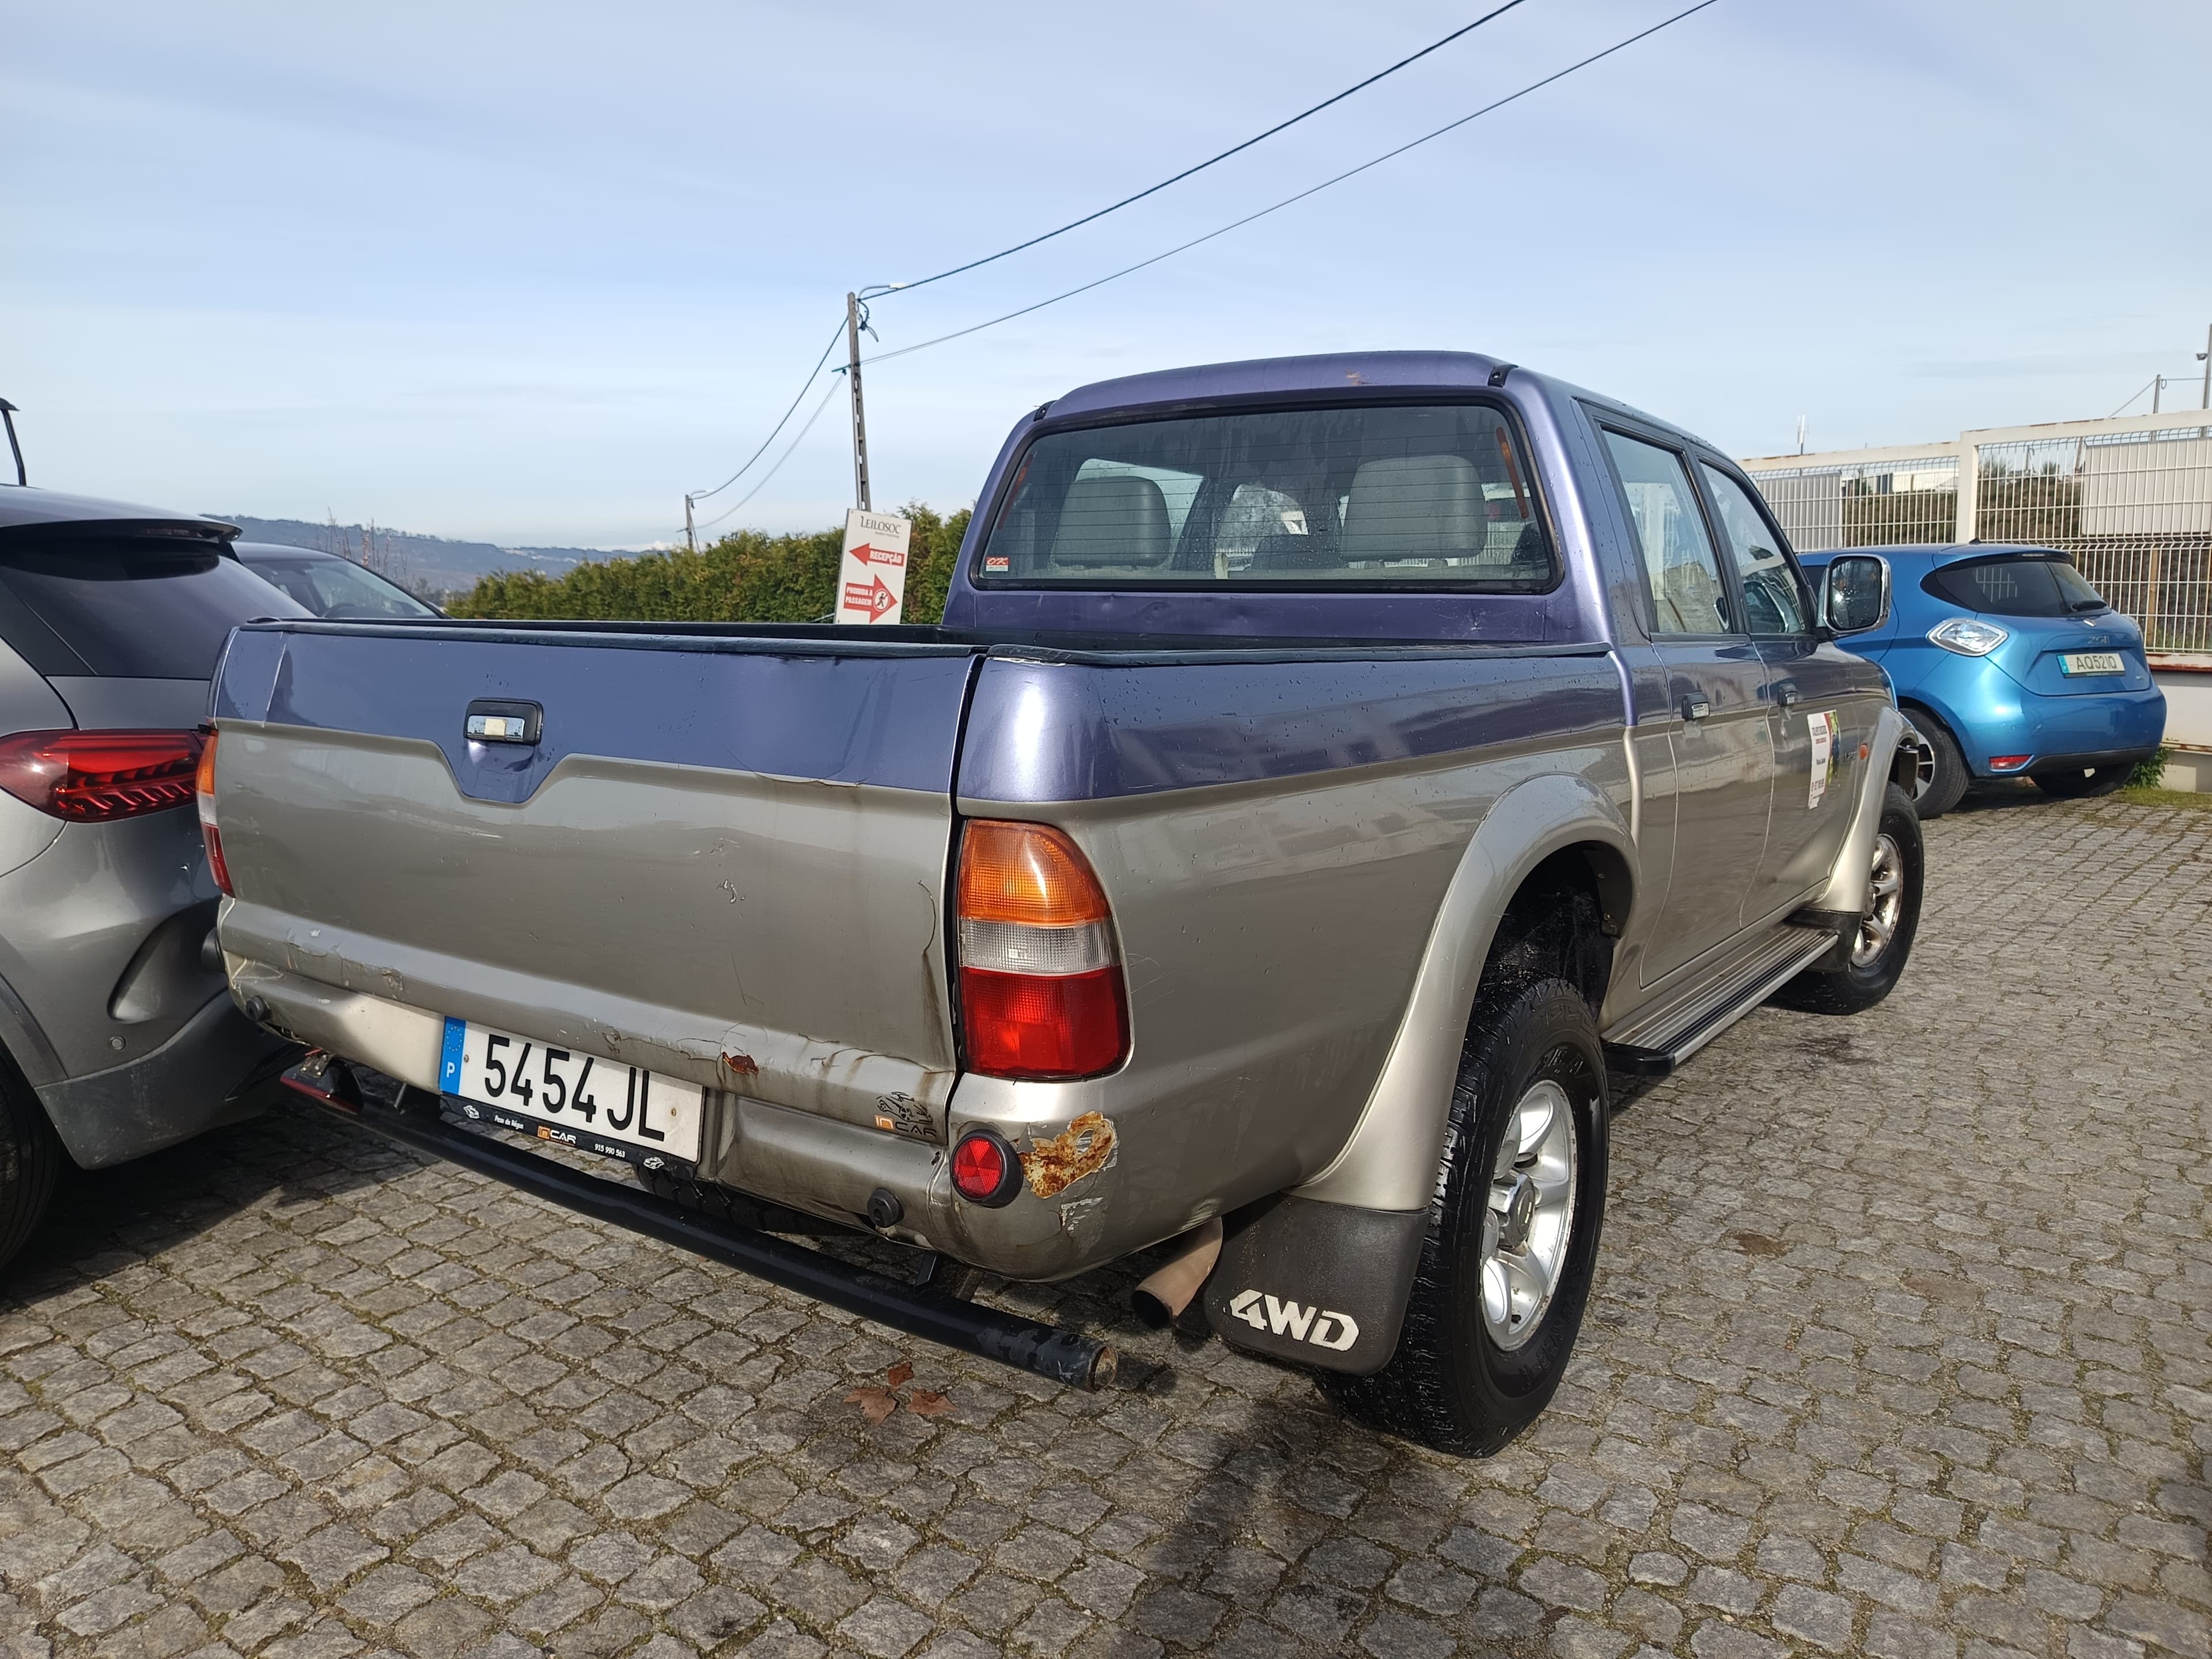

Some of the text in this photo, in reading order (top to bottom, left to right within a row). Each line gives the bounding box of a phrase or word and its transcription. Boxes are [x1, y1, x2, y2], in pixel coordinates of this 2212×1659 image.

[861, 516, 901, 534] LEILOSOC
[870, 550, 902, 564] RECEPÇÃO
[846, 596, 872, 606] PASSAGEM
[446, 1062, 456, 1078] P
[594, 1143, 625, 1158] 915 990 563
[1230, 1289, 1359, 1351] 4WD
